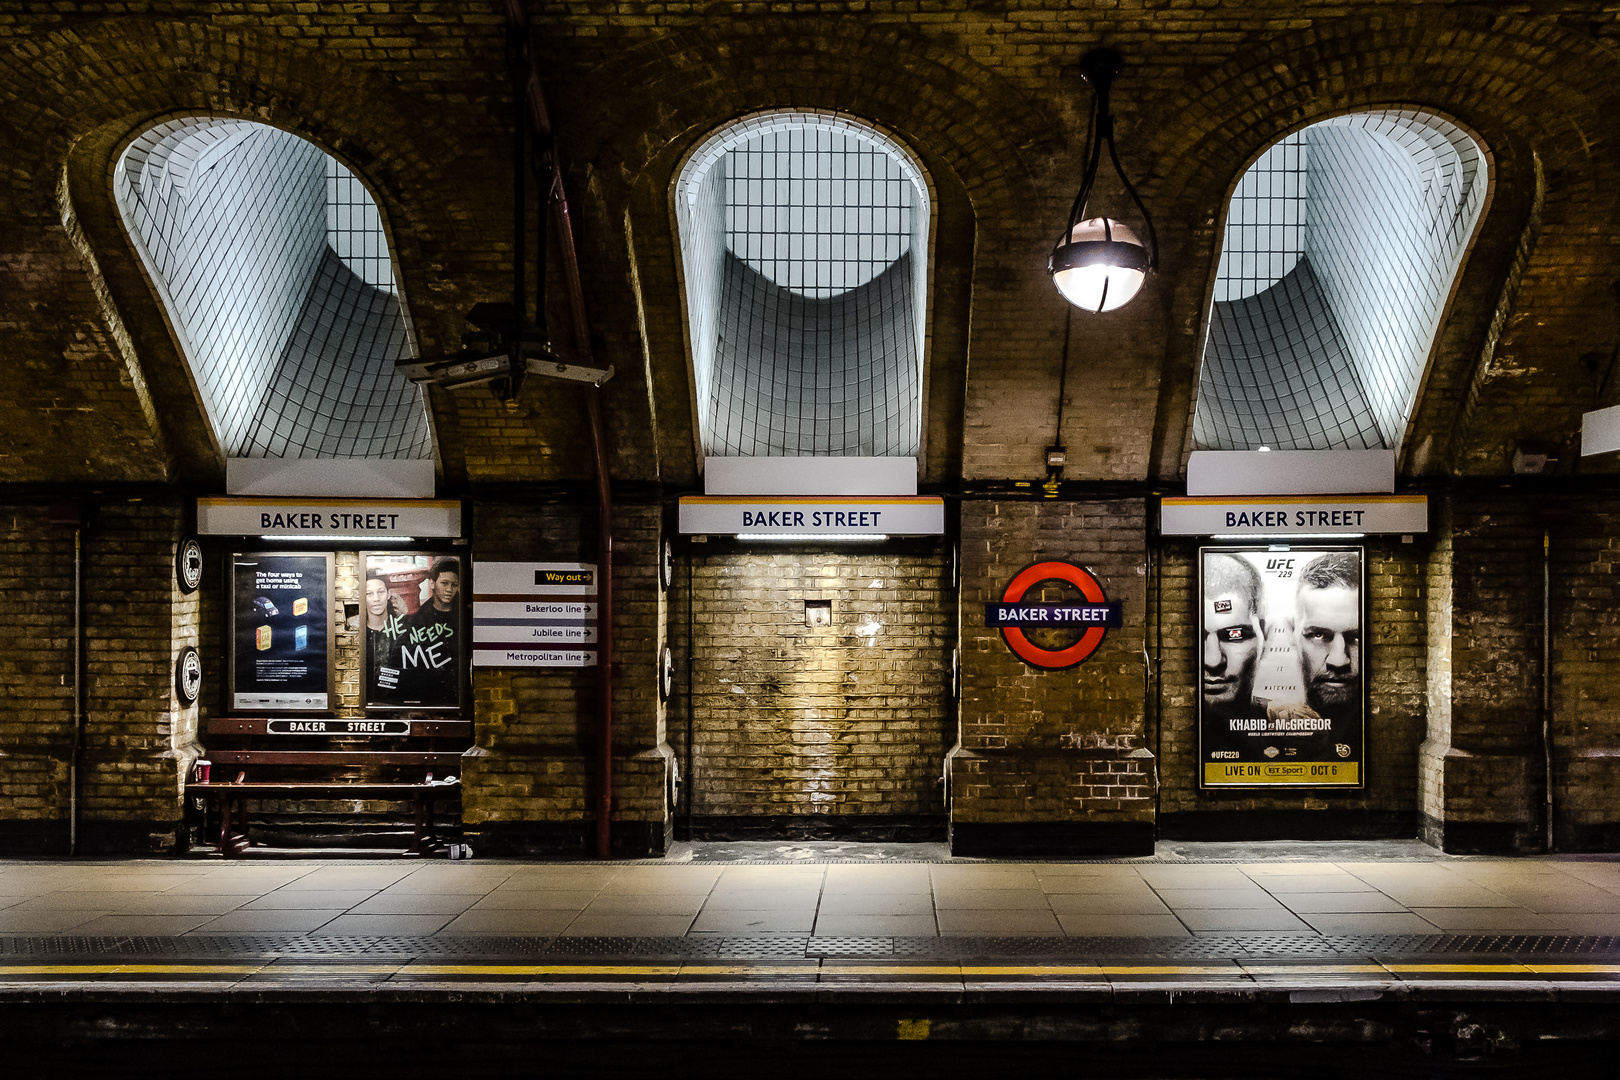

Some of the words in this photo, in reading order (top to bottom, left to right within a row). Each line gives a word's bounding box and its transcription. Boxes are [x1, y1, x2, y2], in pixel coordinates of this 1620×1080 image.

[261, 513, 323, 529] BAKER
[330, 513, 399, 529] STREET
[742, 511, 805, 527] BAKER
[812, 511, 881, 527] STREET
[1226, 511, 1288, 527] BAKER
[1295, 511, 1365, 526] STREET
[1266, 559, 1296, 570] UFC
[283, 577, 299, 585] using
[545, 573, 565, 583] Way
[566, 573, 582, 581] out
[525, 604, 563, 613] Bakerloo
[565, 604, 582, 613] line
[998, 608, 1049, 622] BAKER
[1053, 608, 1110, 622] STREET
[382, 613, 407, 641] HE
[532, 628, 563, 637] Jubilee
[565, 628, 582, 637] line
[409, 622, 454, 645] NEEDS
[401, 641, 452, 670] ME
[506, 652, 563, 662] Metropolitan
[565, 652, 582, 661] line
[289, 722, 326, 732] BAKER
[347, 722, 386, 732] STREET
[1229, 718, 1267, 731] KHABIB
[1275, 718, 1332, 731] McGREGOR
[1225, 766, 1245, 776] LIVE
[1247, 766, 1261, 776] ON
[1281, 766, 1304, 776] Sport
[1310, 765, 1329, 776] OCT
[1331, 765, 1338, 776] 6
